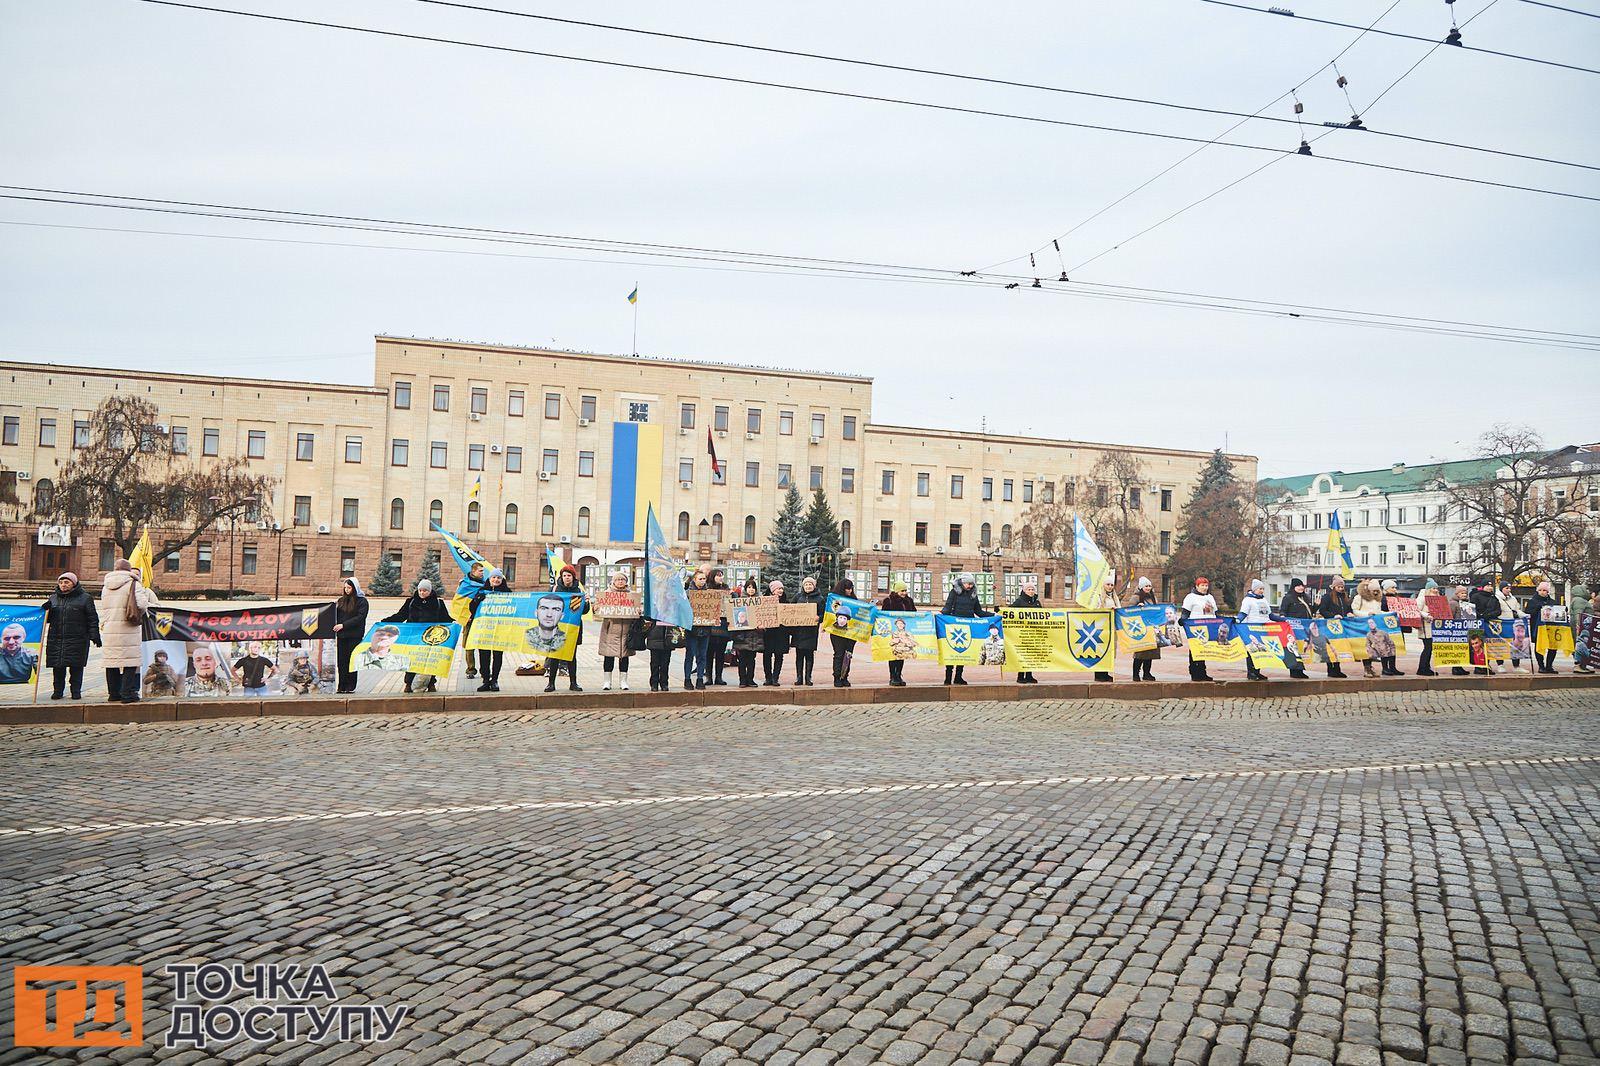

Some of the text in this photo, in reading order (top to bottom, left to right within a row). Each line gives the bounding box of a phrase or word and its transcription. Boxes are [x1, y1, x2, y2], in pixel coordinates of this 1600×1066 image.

[187, 611, 292, 627] Free Azov
[1002, 611, 1051, 620] 56 ОМПБР
[1444, 620, 1462, 629] 56-та
